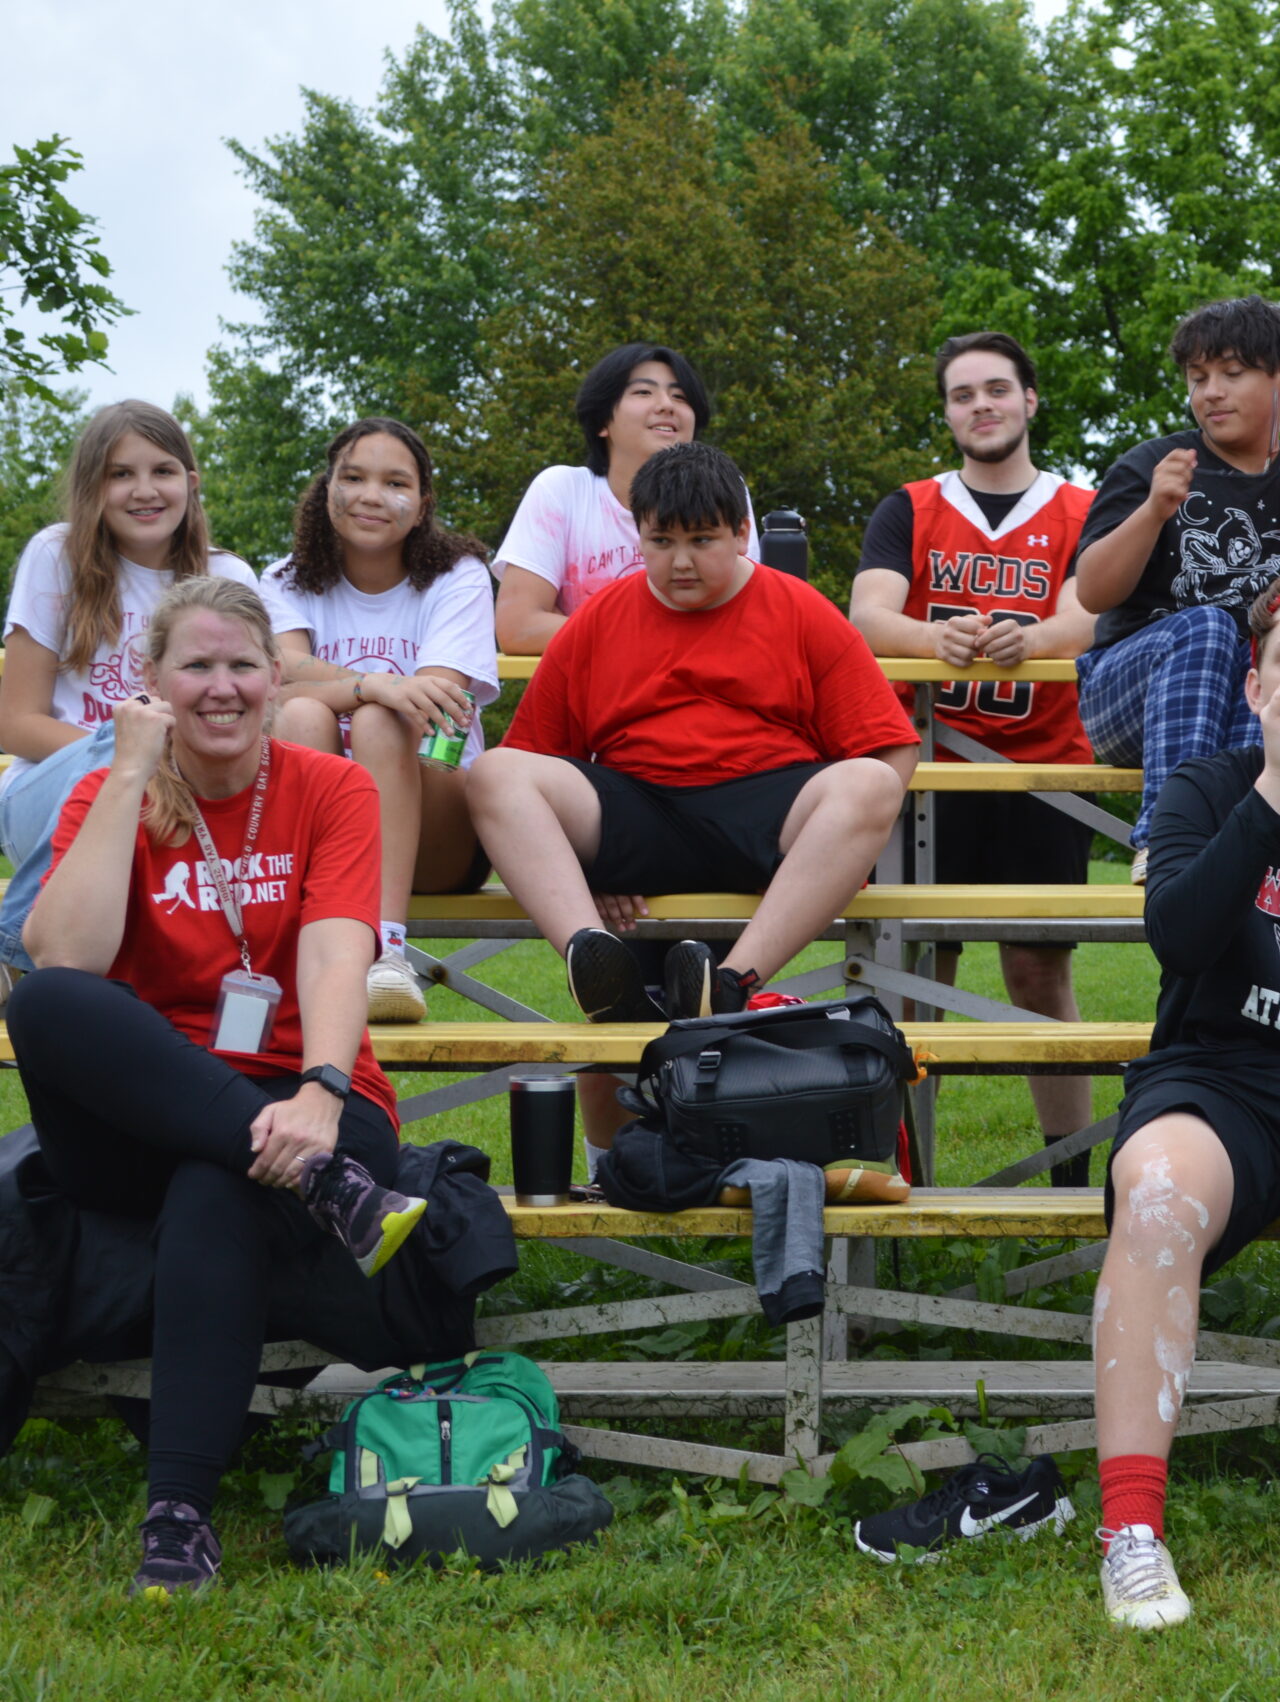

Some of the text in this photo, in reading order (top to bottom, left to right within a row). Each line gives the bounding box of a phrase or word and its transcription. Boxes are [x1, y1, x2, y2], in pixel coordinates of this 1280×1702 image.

[929, 549, 1052, 601] WCDS
[247, 795, 264, 840] COUNTRY
[257, 770, 268, 790] DAY
[195, 853, 294, 886] ROCK THE
